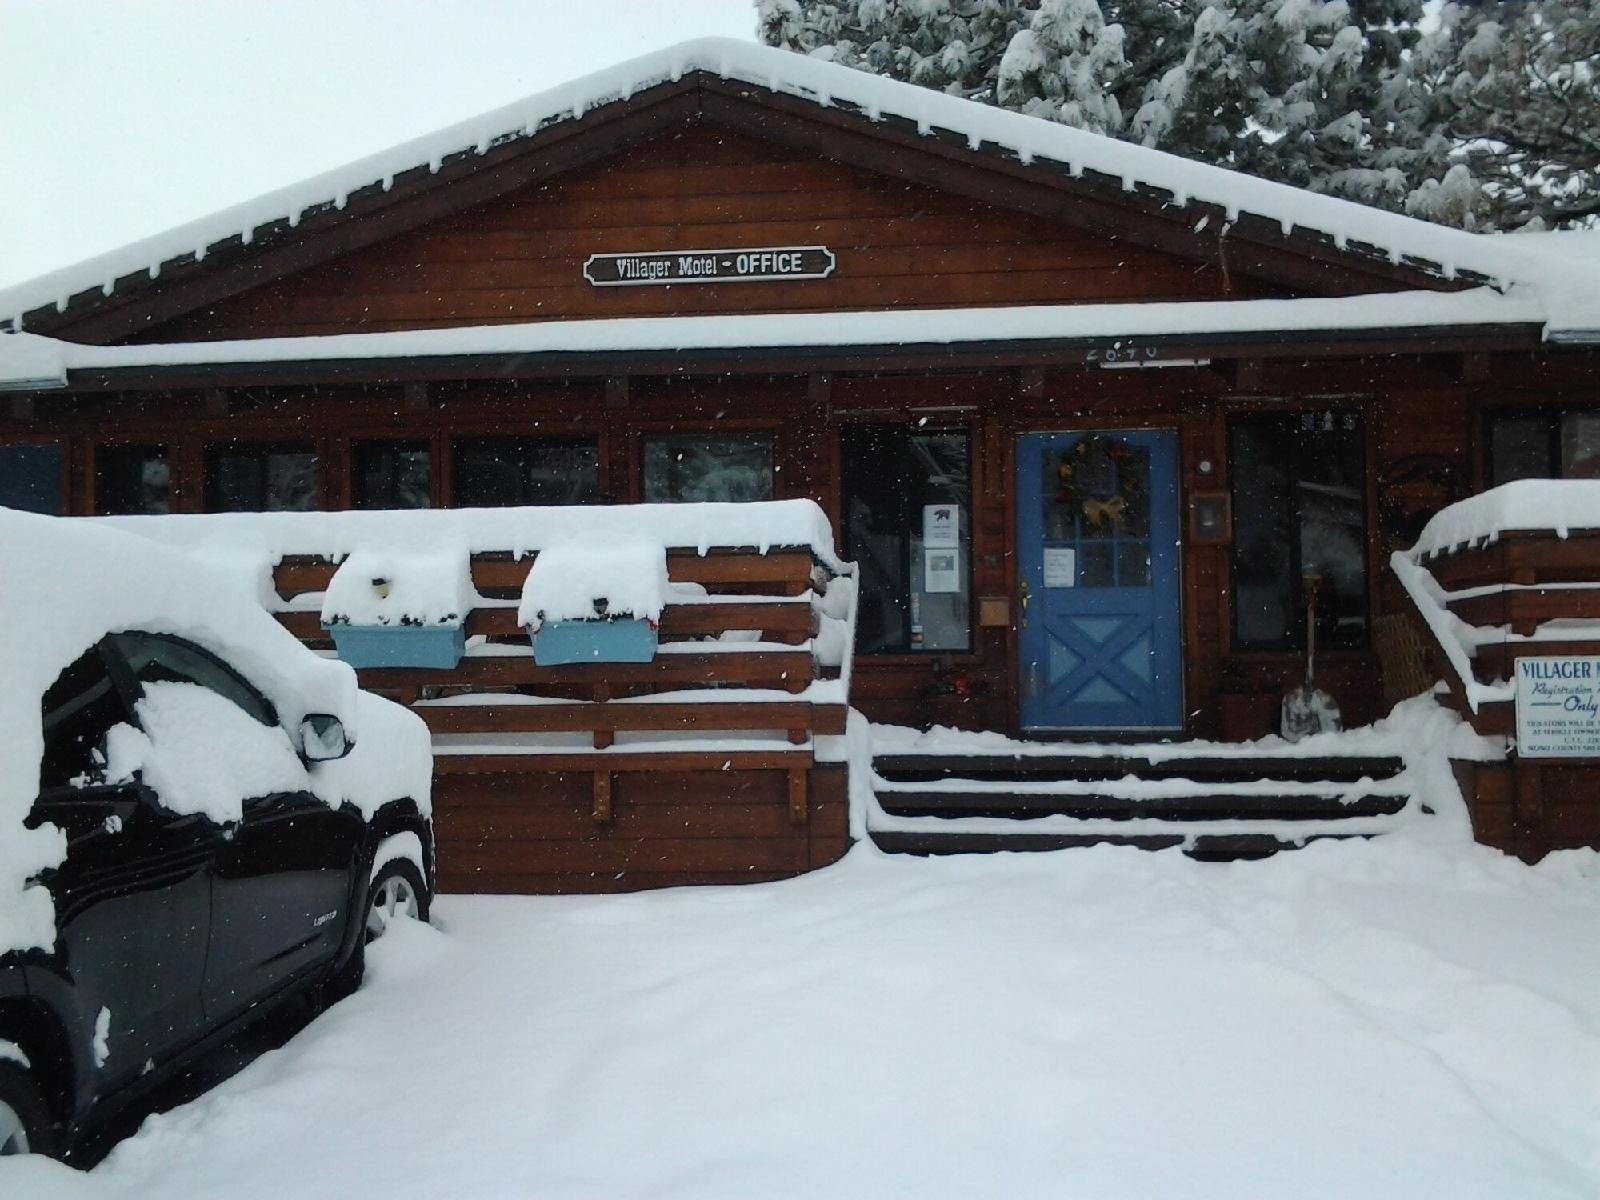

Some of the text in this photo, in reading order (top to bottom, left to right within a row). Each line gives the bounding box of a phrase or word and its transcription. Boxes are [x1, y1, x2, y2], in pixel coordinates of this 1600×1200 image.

[616, 258, 671, 279] Villager
[678, 255, 718, 276] Motel
[736, 252, 802, 274] OFFICE
[1522, 661, 1591, 679] VILLAGER
[1531, 682, 1592, 699] Registration
[1563, 694, 1599, 719] Only
